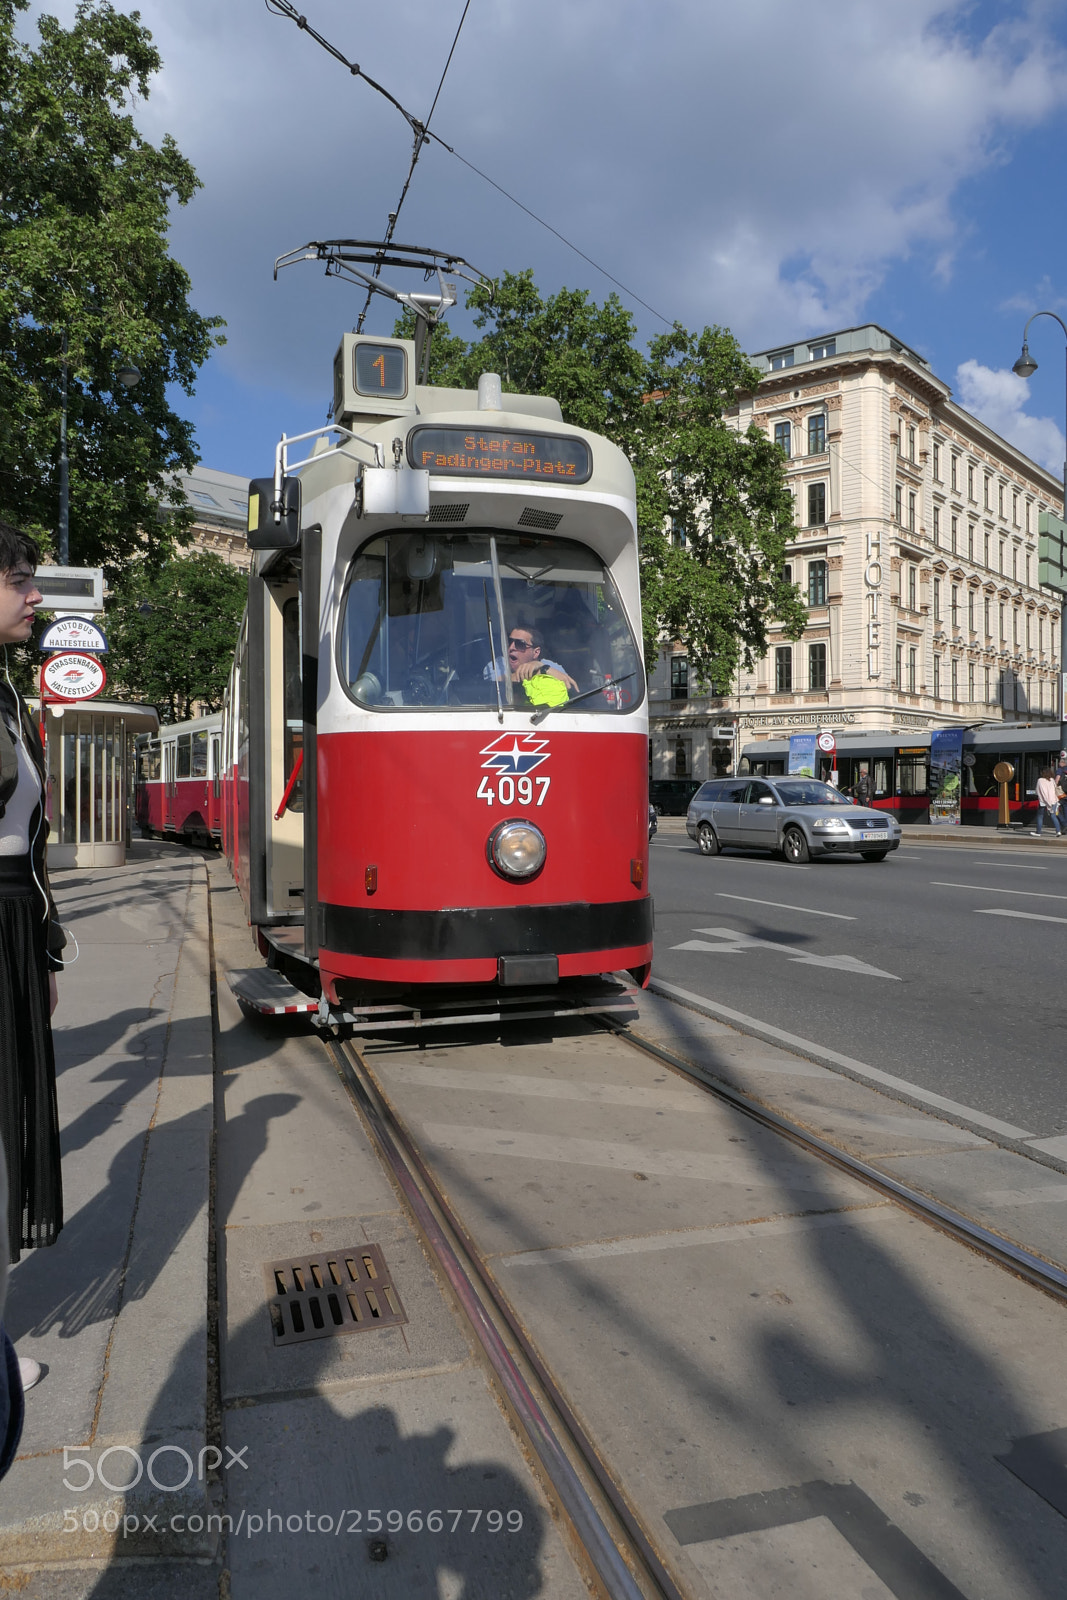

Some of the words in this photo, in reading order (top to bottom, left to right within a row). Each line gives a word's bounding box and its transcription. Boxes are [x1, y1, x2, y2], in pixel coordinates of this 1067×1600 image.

[372, 354, 385, 388] 1
[464, 436, 535, 455] Stefan
[422, 451, 576, 476] Fadinger-Platz
[864, 531, 883, 679] HOTEL
[56, 621, 94, 635] AUTOBUS
[49, 639, 100, 648] HALTESTELLE
[48, 657, 99, 675] STRASSENBAHN
[50, 680, 97, 695] HALTESTELLE
[713, 717, 733, 728] Ba
[741, 716, 771, 727] HOTEL
[772, 715, 784, 725] AM
[788, 713, 855, 725] SCHUBERTRING
[476, 776, 551, 806] 4097
